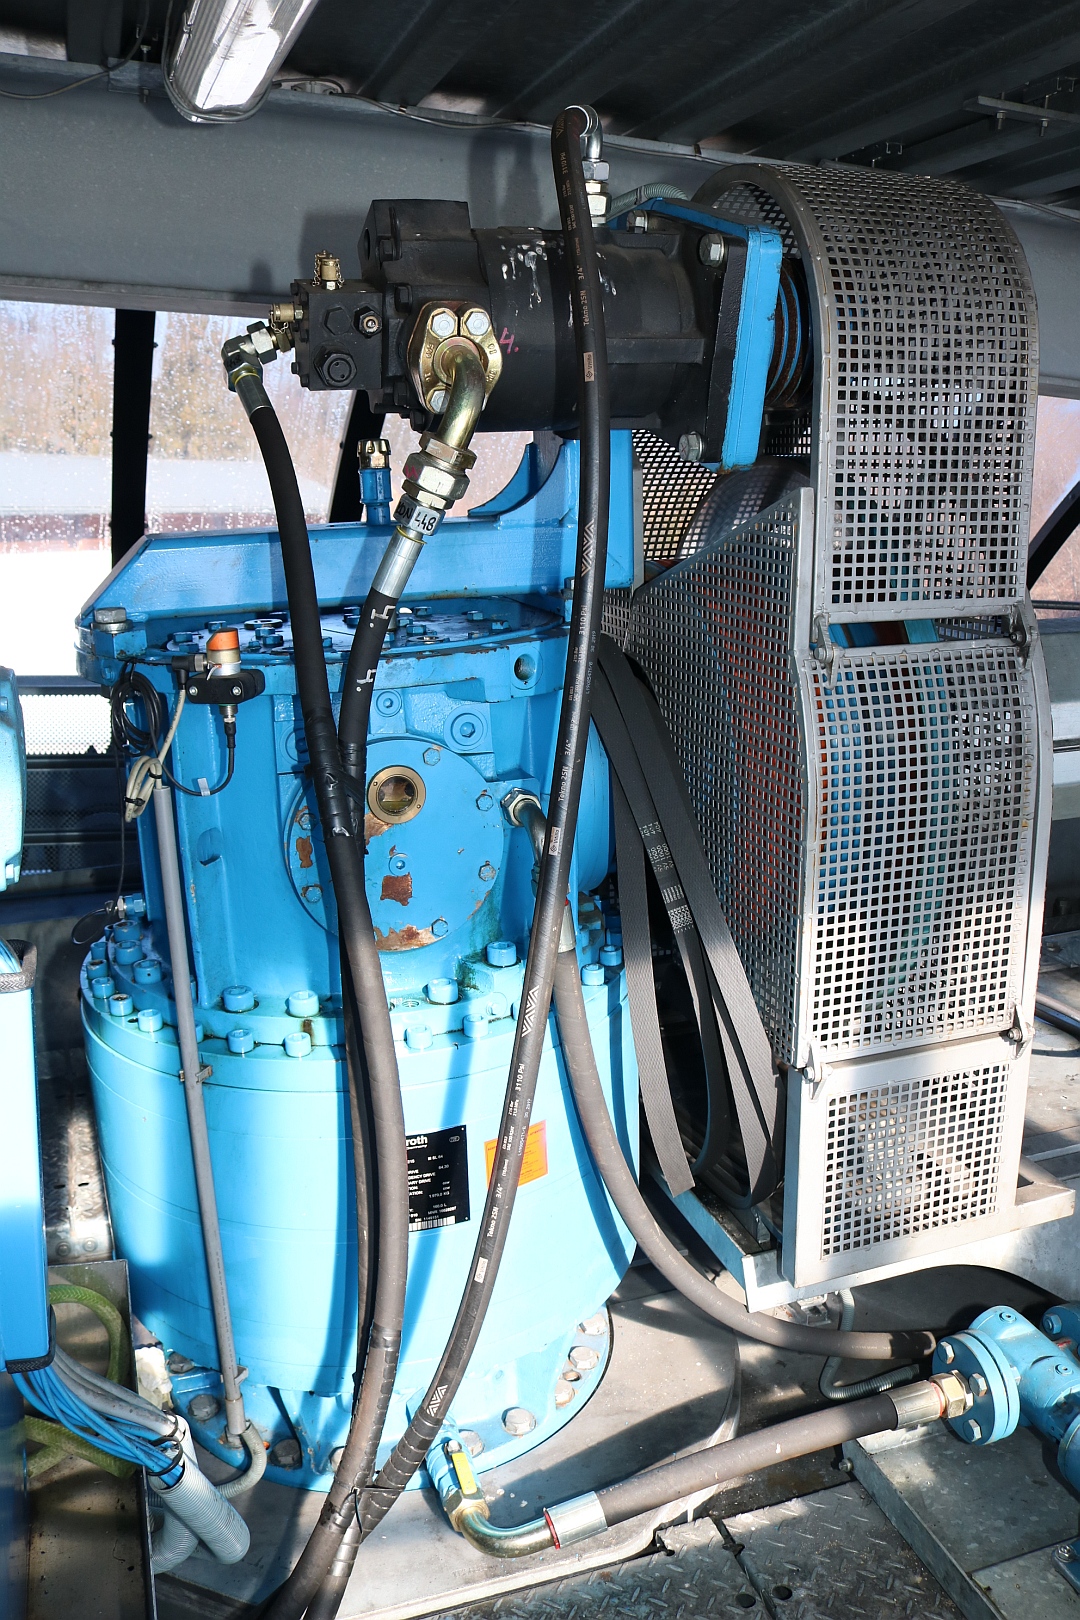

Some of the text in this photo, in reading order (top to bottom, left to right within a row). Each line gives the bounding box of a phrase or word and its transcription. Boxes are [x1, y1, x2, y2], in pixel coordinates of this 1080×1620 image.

[582, 306, 590, 326] Tekno
[415, 512, 436, 531] 448
[580, 605, 588, 616] Psi
[515, 1074, 523, 1092] 3110
[406, 1135, 428, 1146] roth
[491, 1206, 499, 1220] 2SN
[487, 1219, 496, 1238] Tekno
